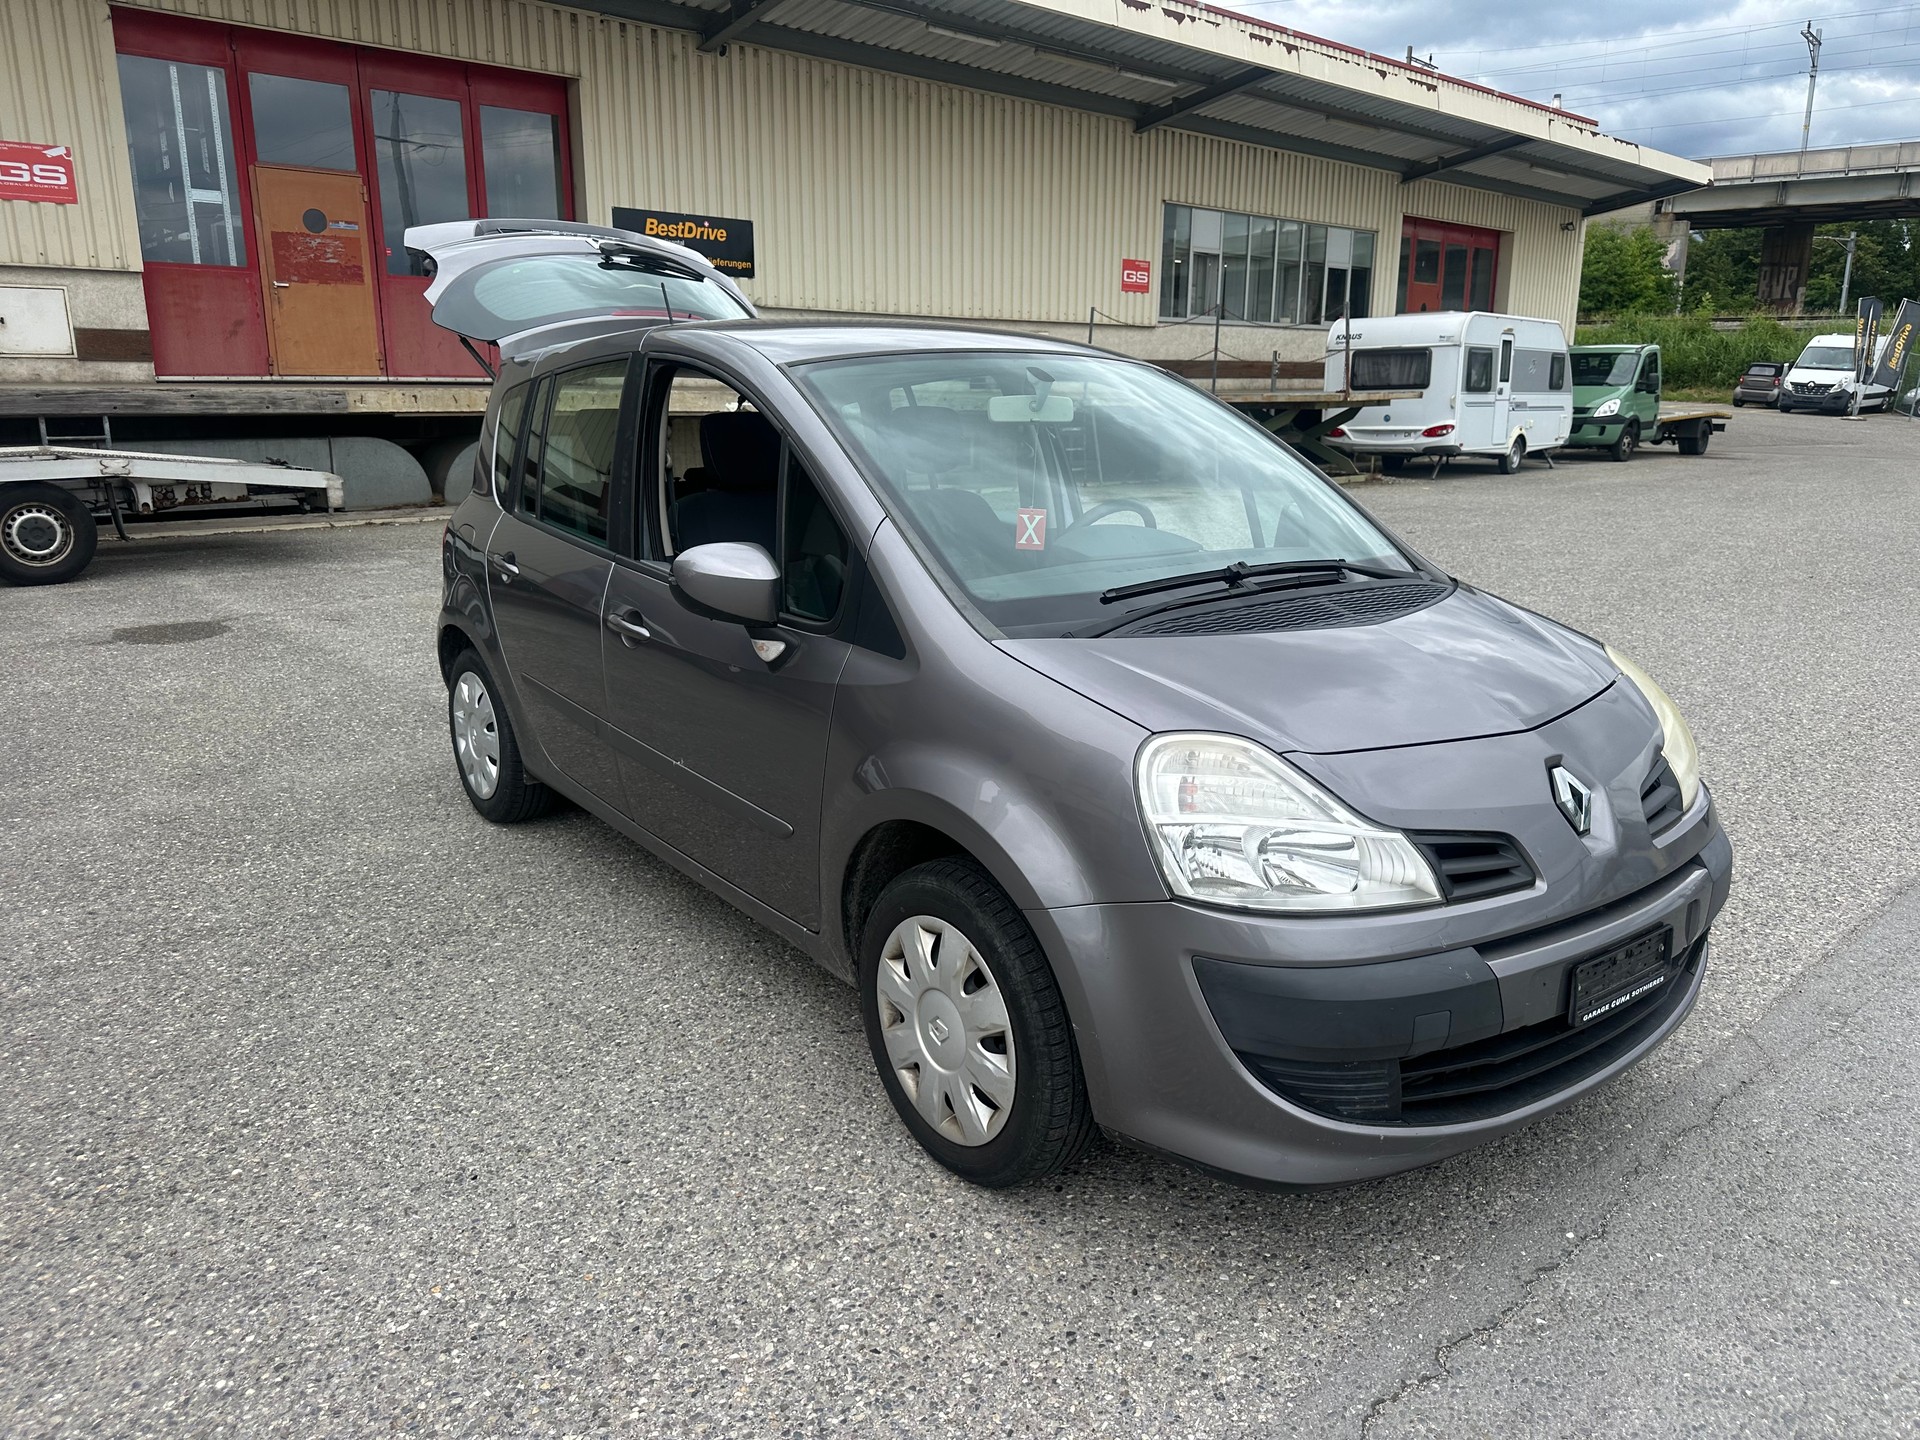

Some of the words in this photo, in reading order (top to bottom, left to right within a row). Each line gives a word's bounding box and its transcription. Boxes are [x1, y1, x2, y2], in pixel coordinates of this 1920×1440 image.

[0, 161, 68, 185] GS
[645, 217, 727, 241] BestDrive
[1123, 270, 1148, 283] GS
[1888, 323, 1912, 370] BestDrive
[1017, 514, 1045, 545] X
[1583, 1003, 1610, 1021] GARAGE
[1610, 993, 1631, 1008] CUNA
